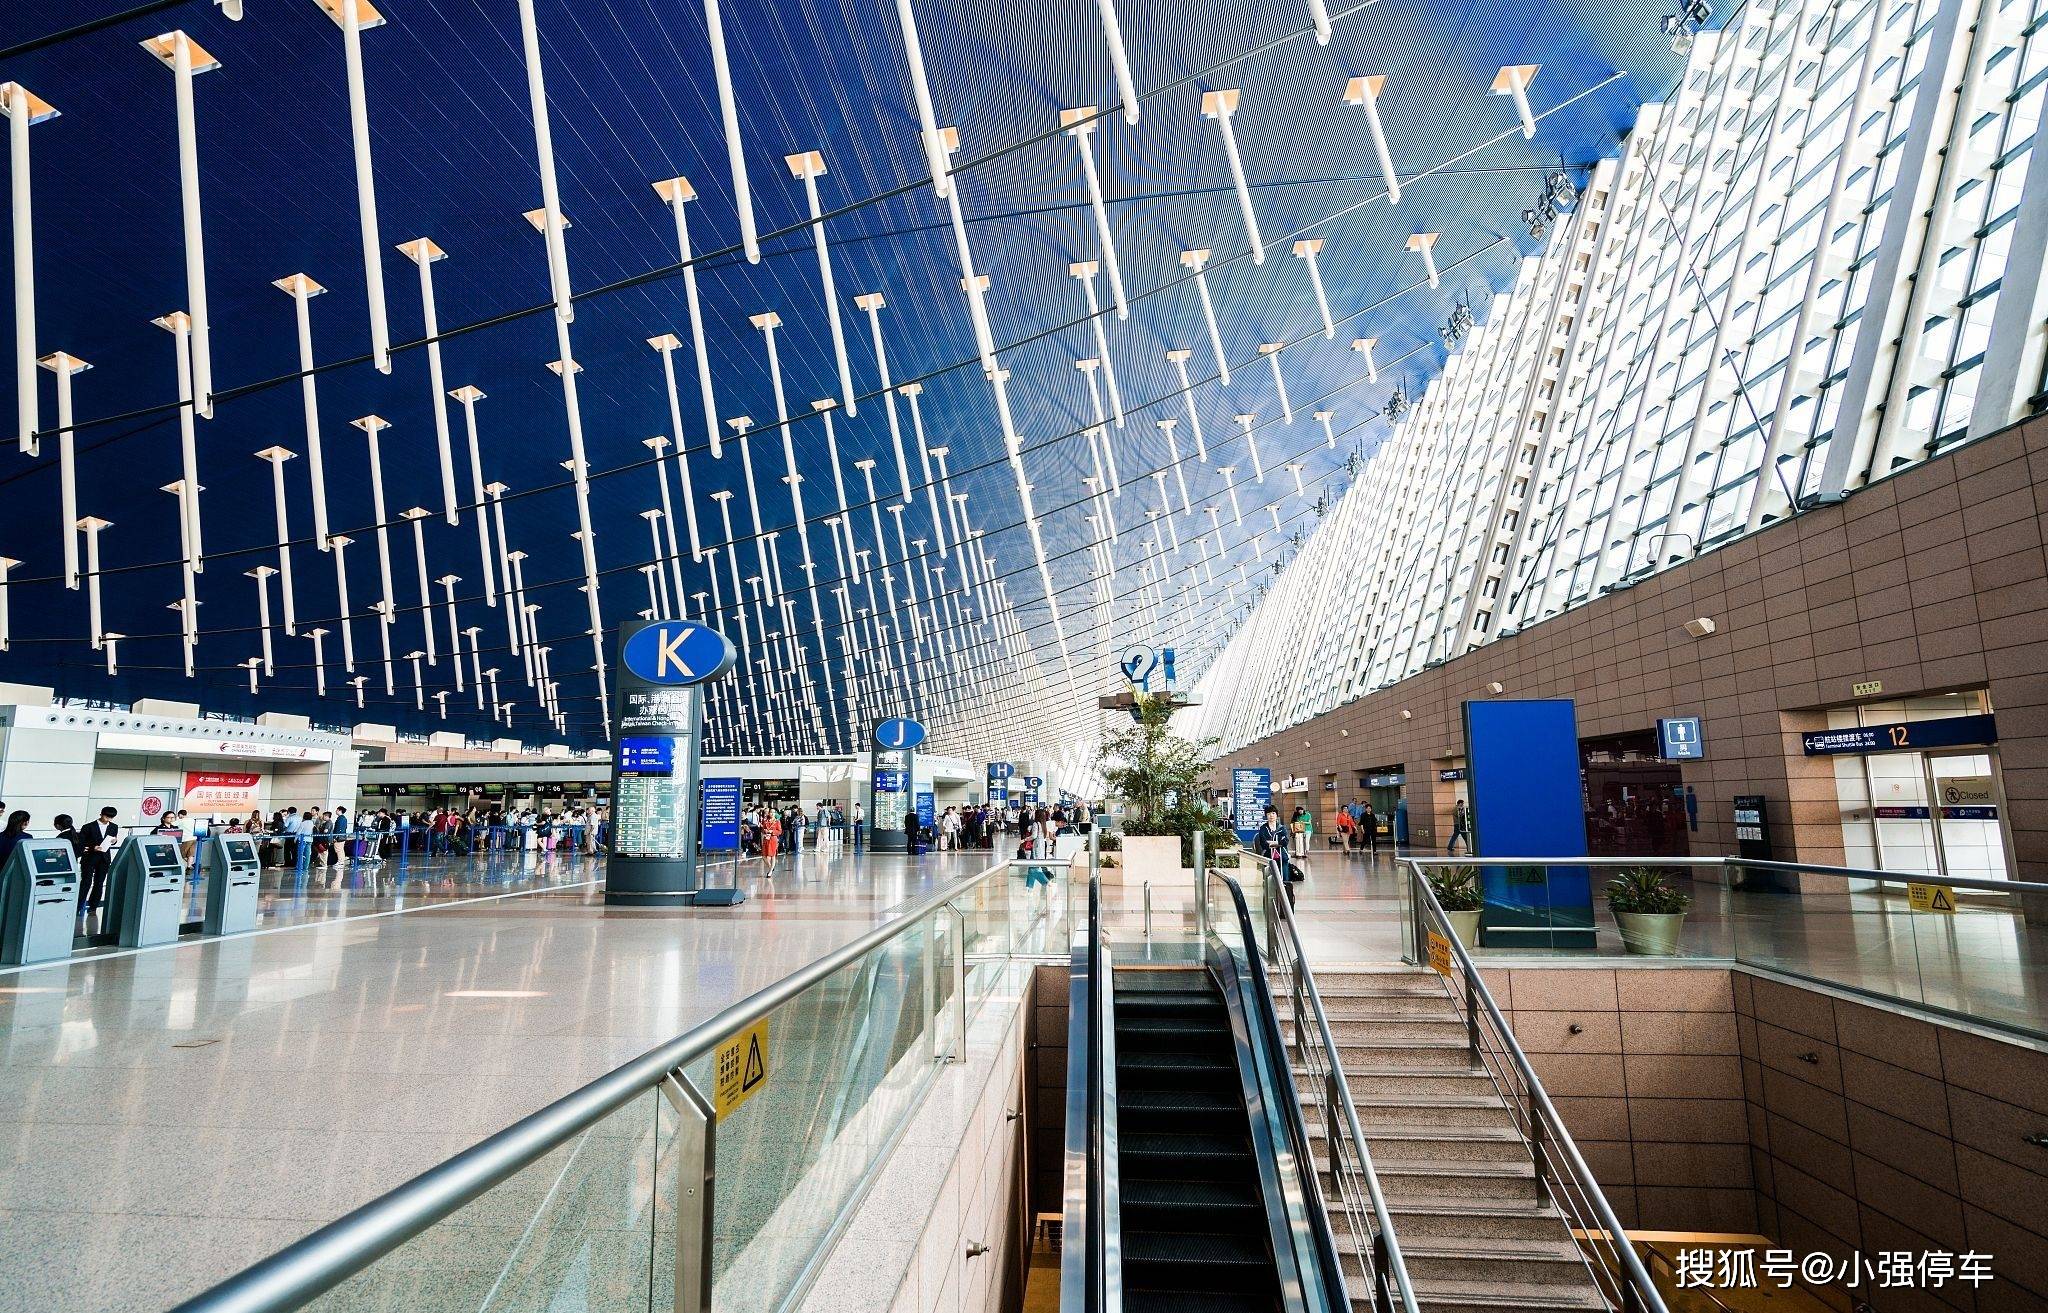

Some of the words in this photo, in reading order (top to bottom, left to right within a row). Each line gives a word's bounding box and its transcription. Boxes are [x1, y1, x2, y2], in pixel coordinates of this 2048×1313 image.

[657, 628, 695, 677] K
[893, 721, 905, 746] J
[1888, 726, 1910, 746] 12
[997, 764, 1008, 777] H
[1029, 777, 1038, 787] G
[1960, 790, 1989, 800] Closed
